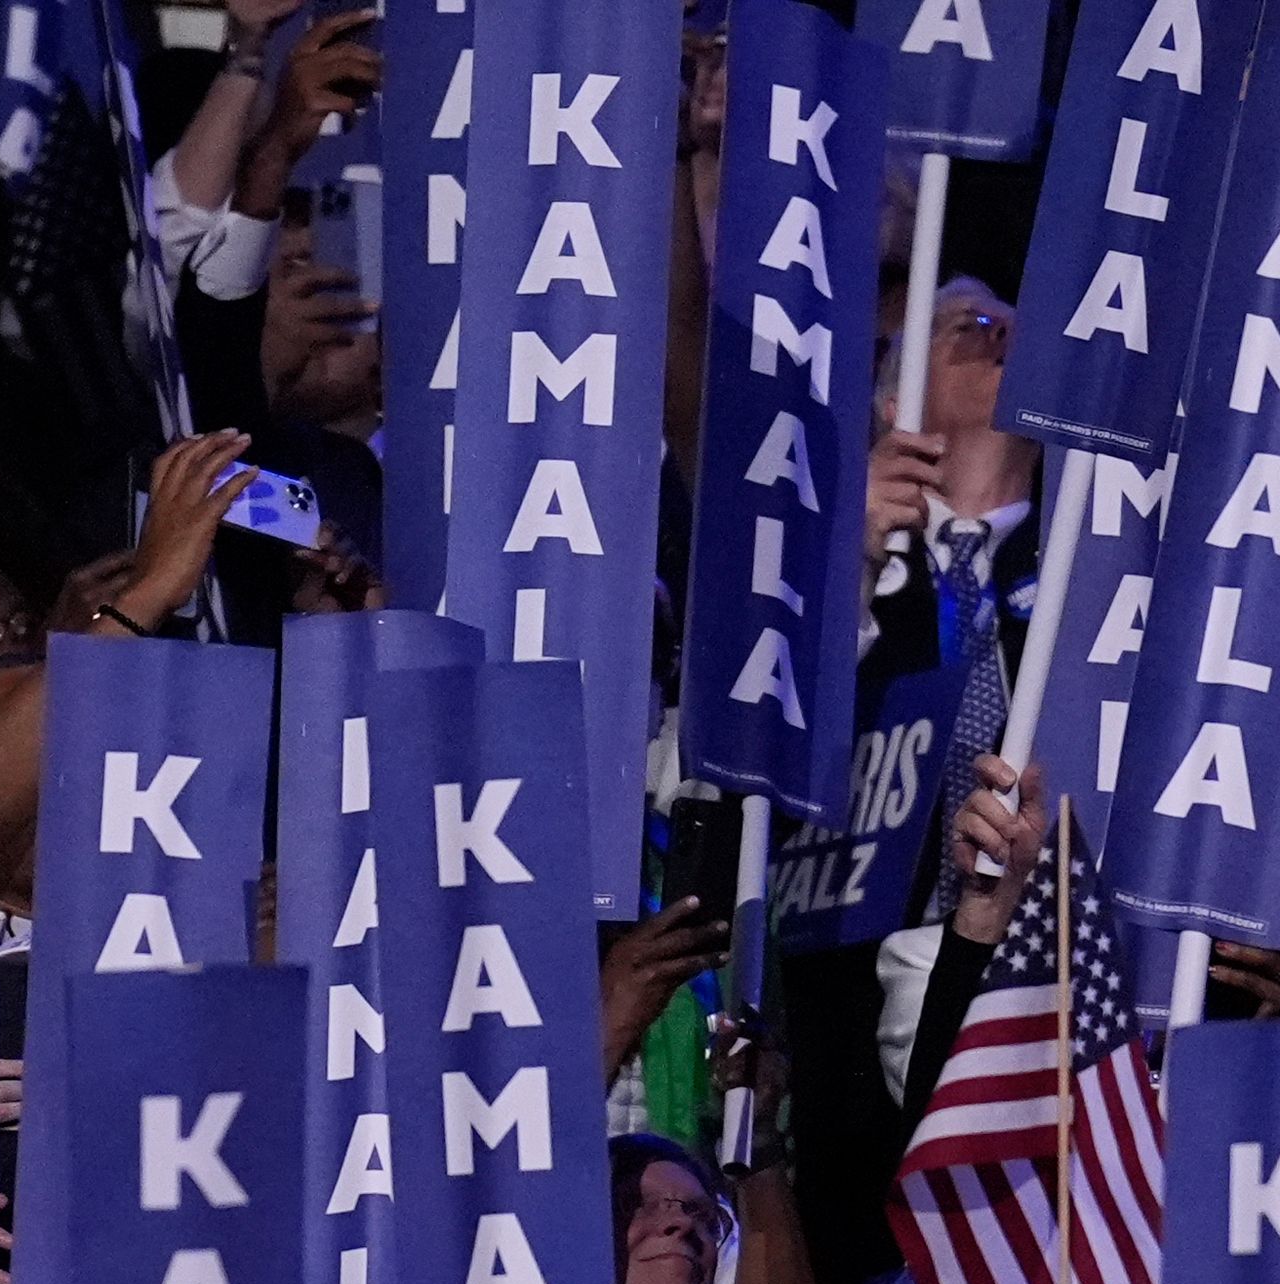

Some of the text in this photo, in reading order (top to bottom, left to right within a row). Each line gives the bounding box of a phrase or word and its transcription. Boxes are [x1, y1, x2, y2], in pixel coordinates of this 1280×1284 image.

[727, 84, 839, 730] KAMALA
[1021, 412, 1044, 425] PAID
[1092, 429, 1111, 440] FOR
